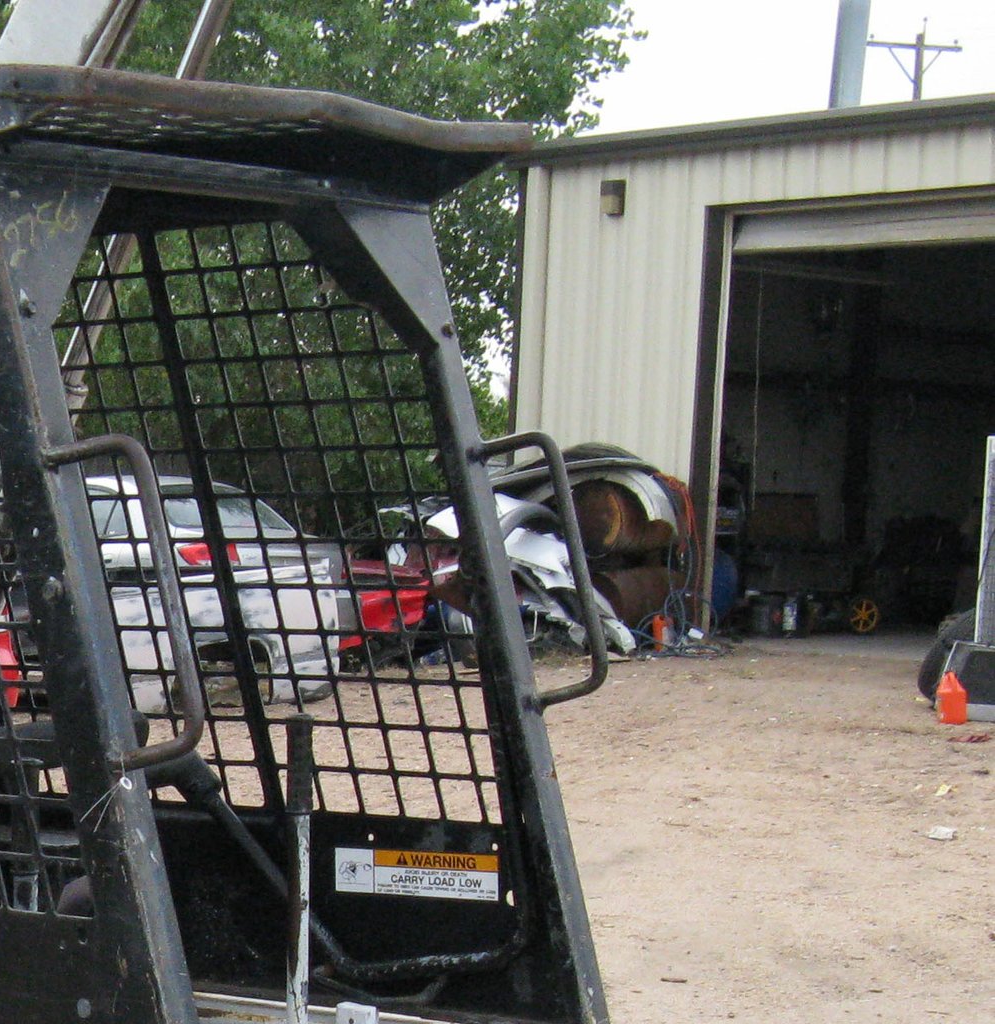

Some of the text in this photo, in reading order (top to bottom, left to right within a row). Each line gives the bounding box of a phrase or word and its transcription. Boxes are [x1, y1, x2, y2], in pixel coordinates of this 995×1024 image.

[411, 855, 476, 869] WARNING
[390, 874, 425, 886] CARRY
[428, 876, 455, 887] LOAD
[459, 878, 482, 889] LOW
